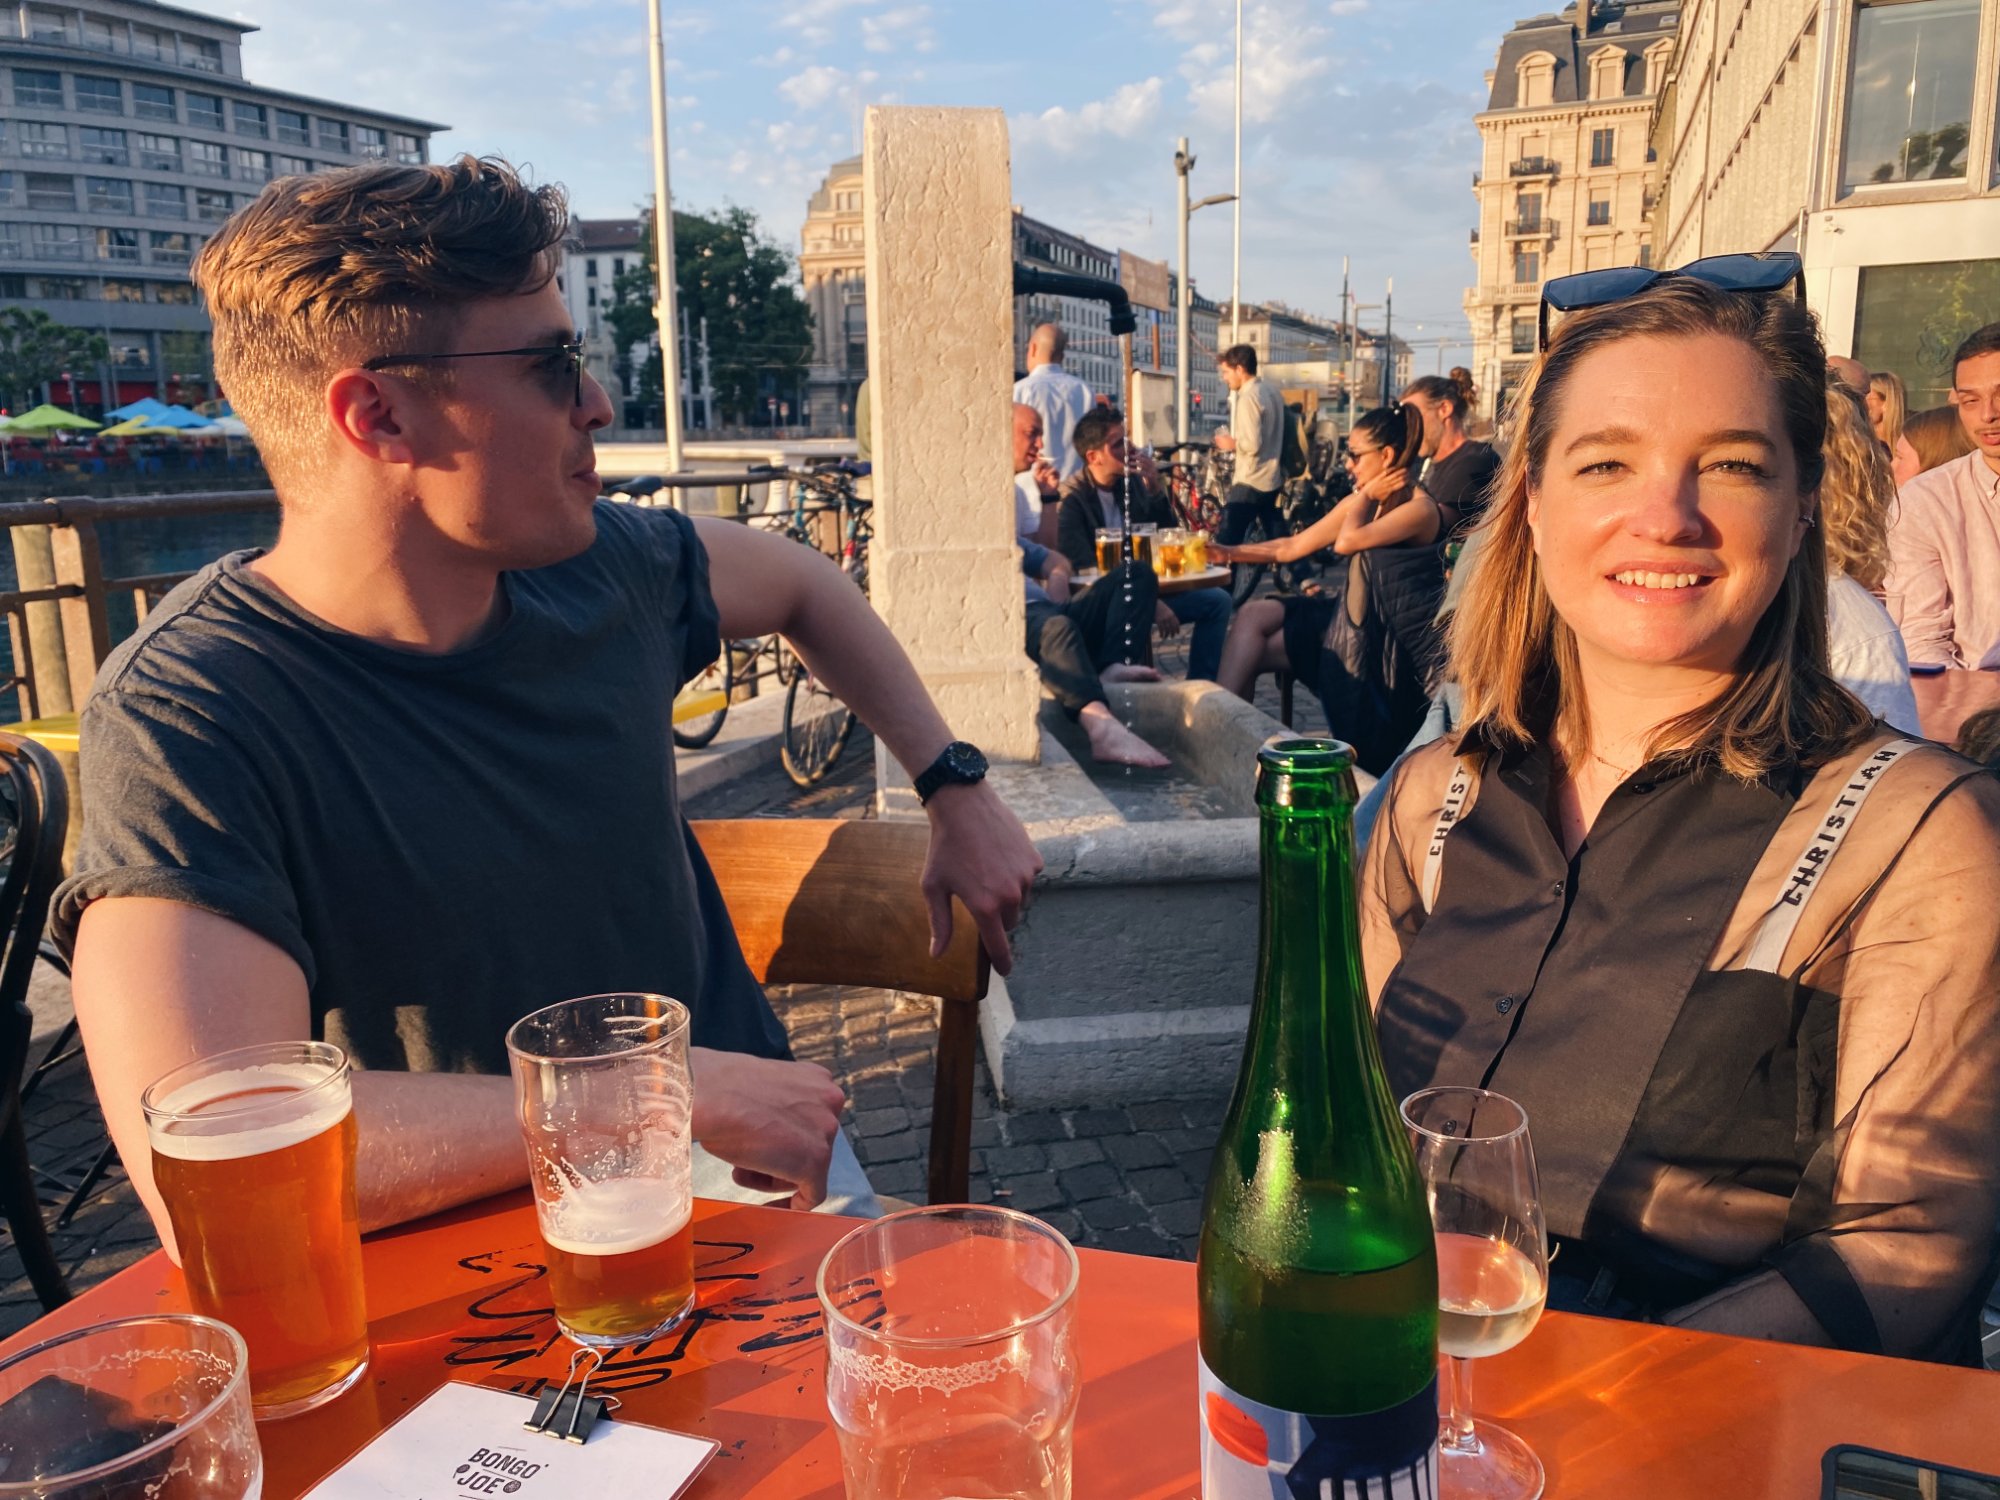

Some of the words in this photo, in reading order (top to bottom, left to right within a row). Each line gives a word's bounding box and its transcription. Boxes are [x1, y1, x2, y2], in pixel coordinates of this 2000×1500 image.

[1782, 750, 1898, 906] CHRISTIAN
[468, 1448, 541, 1479] BONGO
[457, 1471, 505, 1494] JOE
